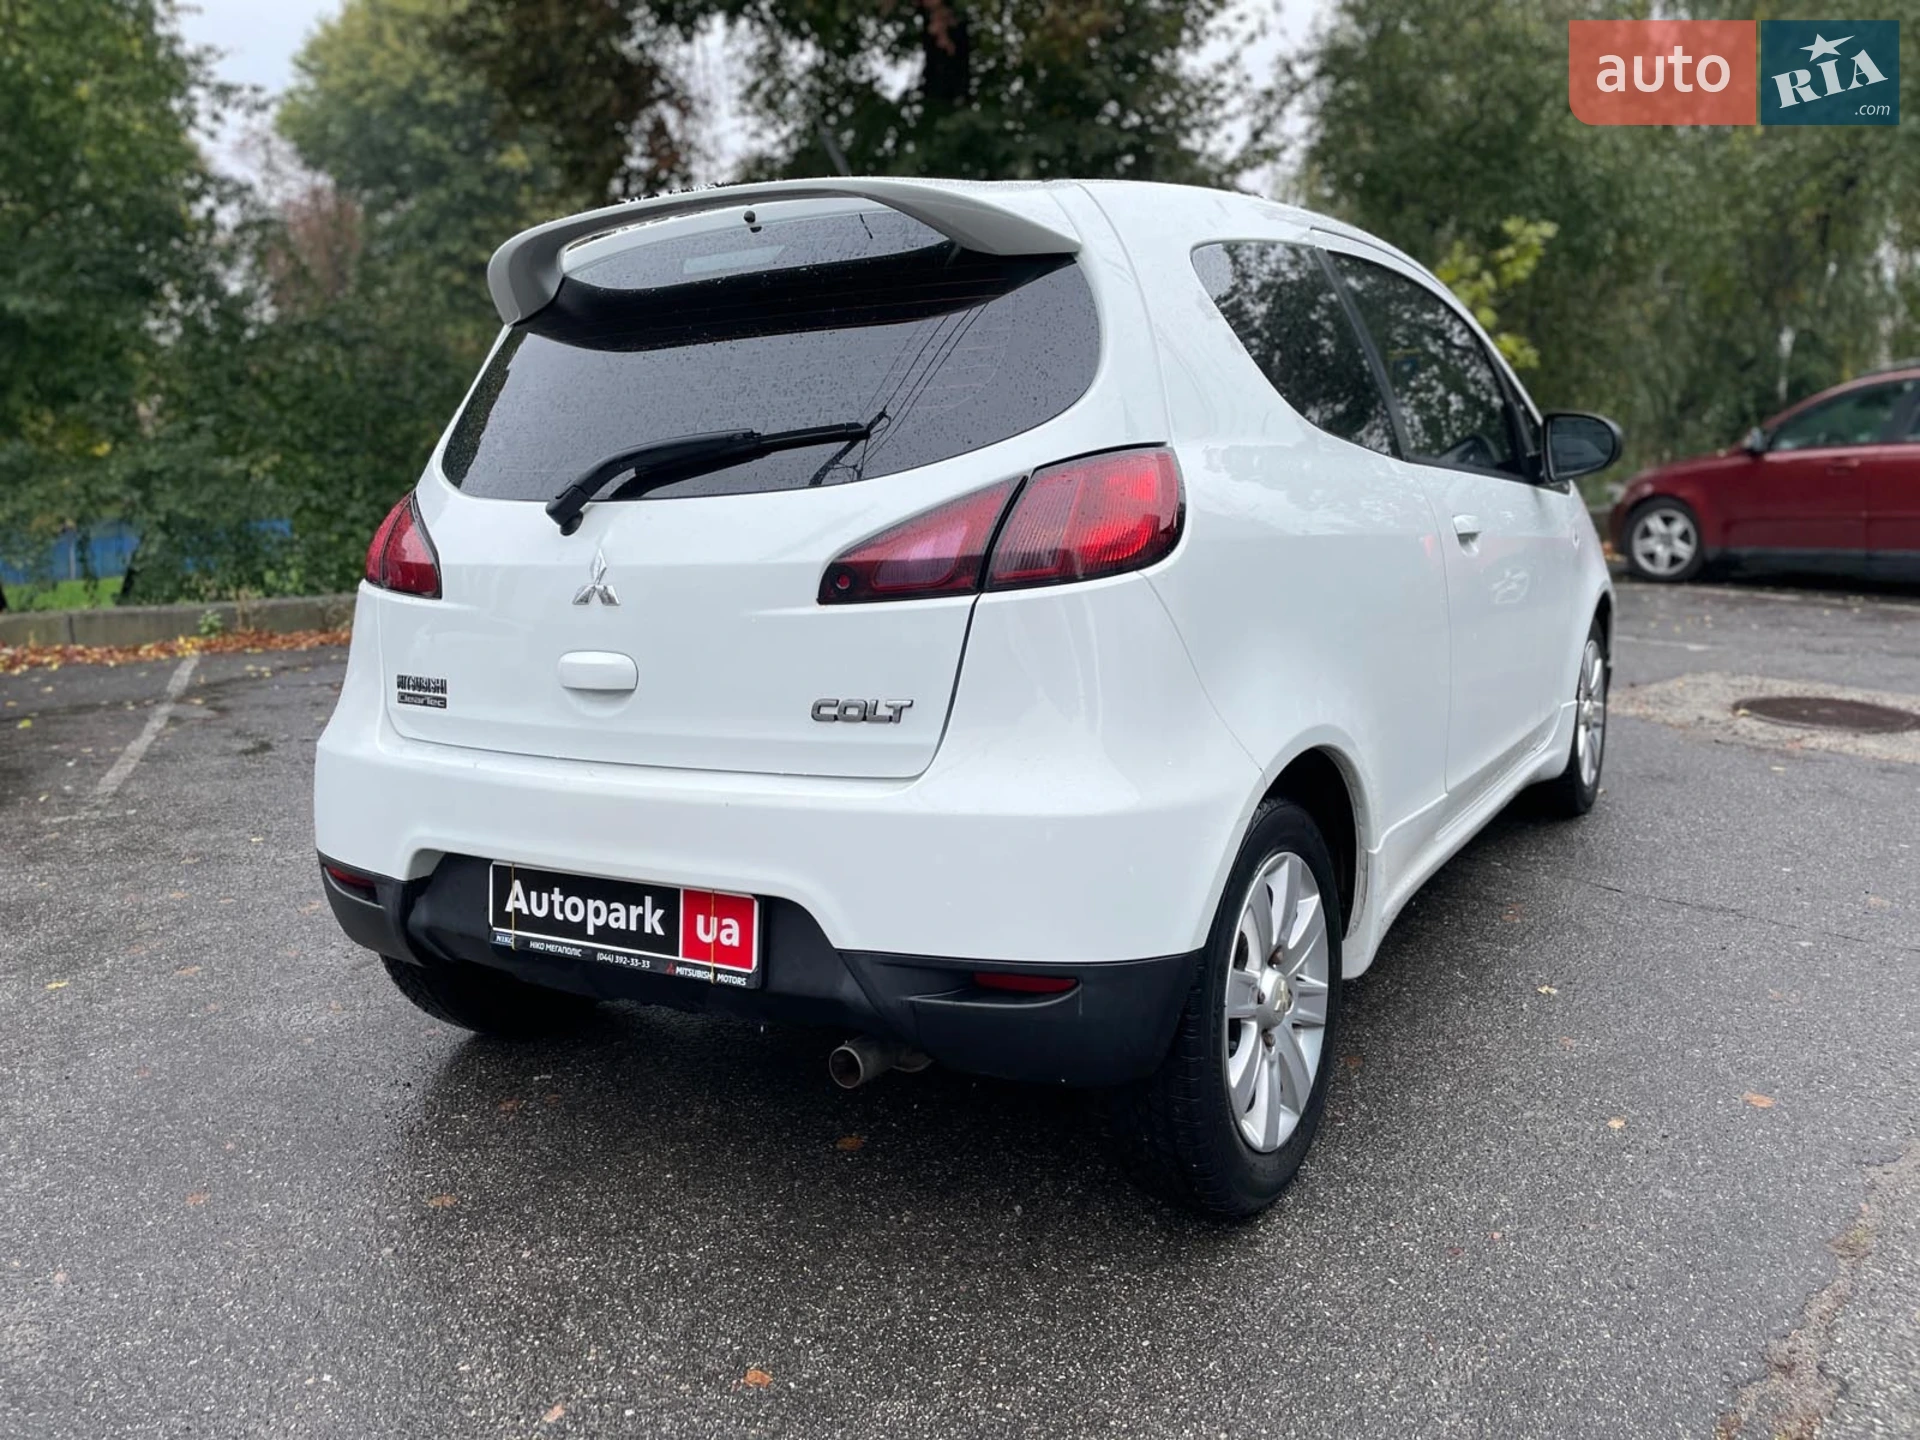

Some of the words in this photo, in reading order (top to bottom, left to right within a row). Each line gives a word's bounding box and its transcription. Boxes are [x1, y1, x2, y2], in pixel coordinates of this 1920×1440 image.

[396, 674, 447, 695] MITSUBISHI
[811, 698, 914, 723] COLT
[505, 879, 665, 936] Autopark
[696, 913, 740, 947] ua
[597, 952, 614, 964] (044)
[615, 955, 650, 969] 392-33-33
[676, 966, 713, 980] MITSUBISH
[716, 973, 747, 986] MOTORS
